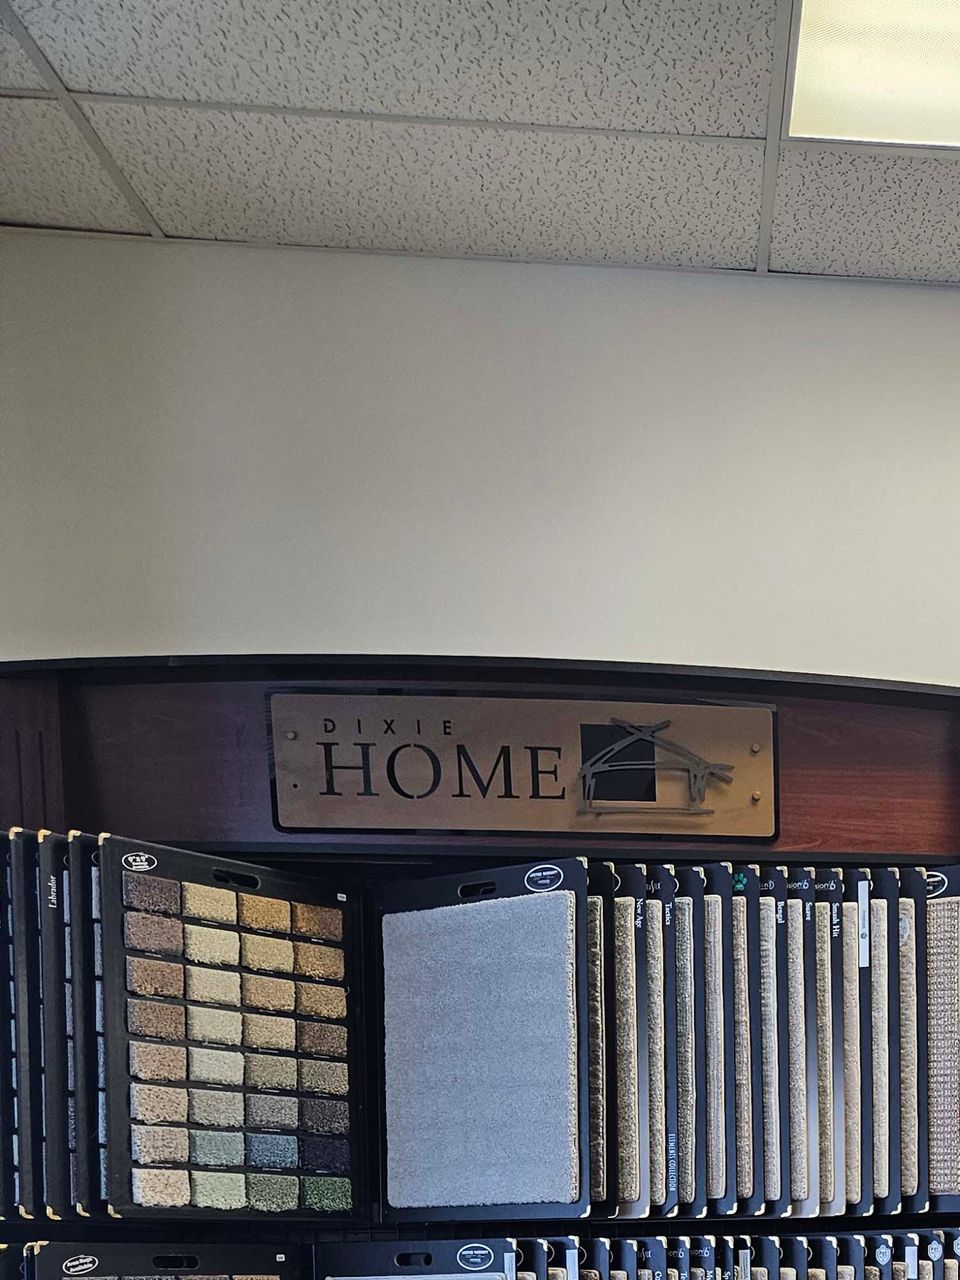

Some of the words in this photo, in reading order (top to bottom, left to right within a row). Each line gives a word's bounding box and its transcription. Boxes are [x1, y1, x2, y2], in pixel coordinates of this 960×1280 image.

[323, 717, 453, 737] DIXIE
[316, 741, 567, 800] HOME
[48, 875, 57, 908] Labrador
[635, 898, 644, 914] New
[665, 902, 673, 925] Tactics
[776, 901, 785, 924] Bengal
[832, 902, 840, 924] Smash
[635, 915, 644, 928] Age
[832, 925, 840, 937] Hit
